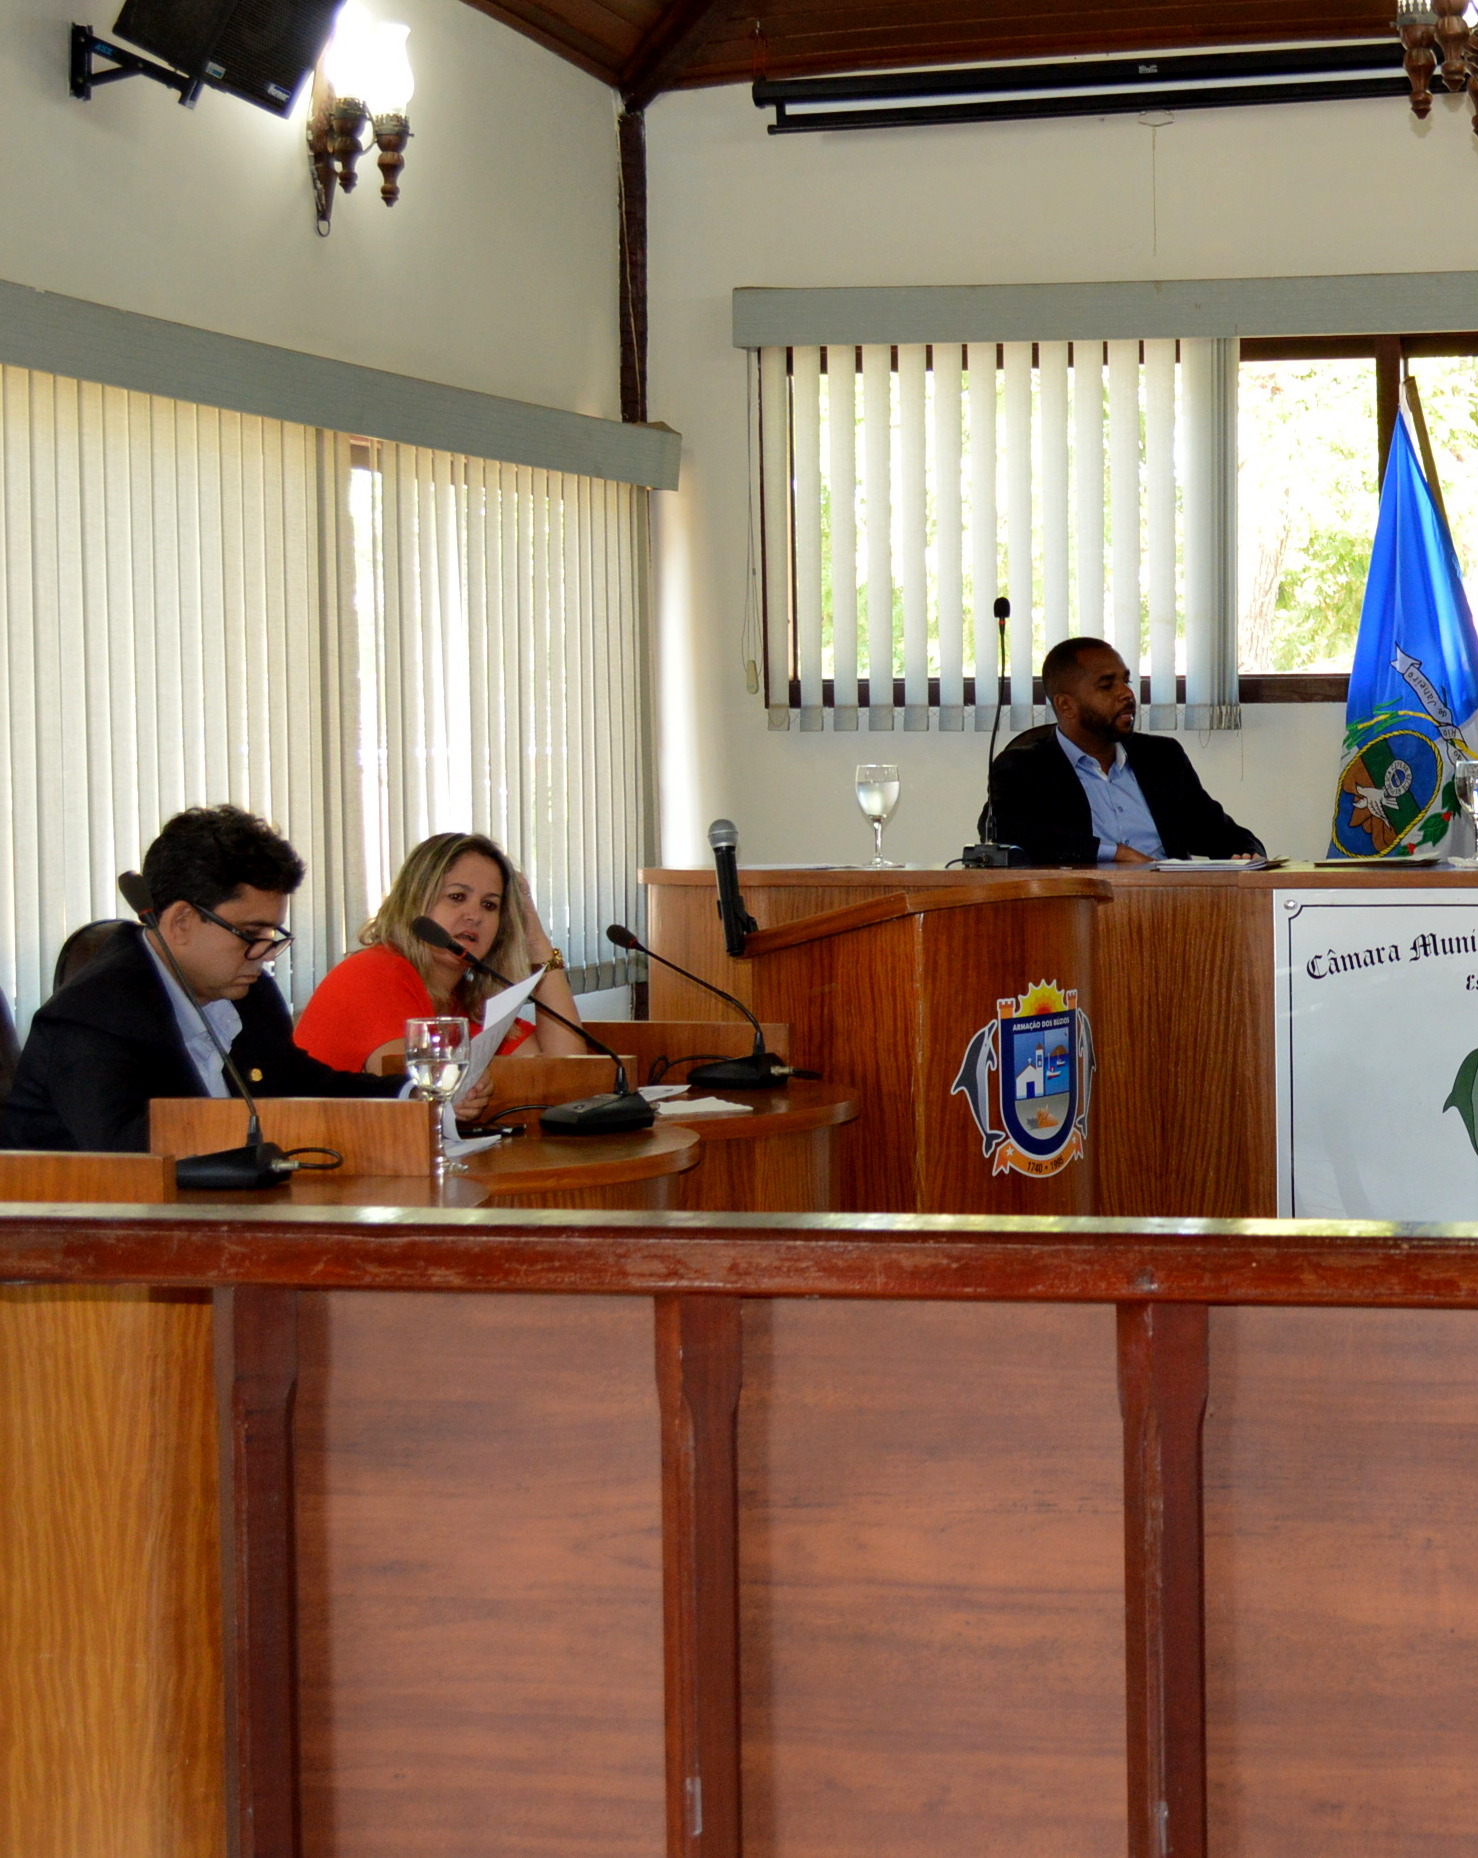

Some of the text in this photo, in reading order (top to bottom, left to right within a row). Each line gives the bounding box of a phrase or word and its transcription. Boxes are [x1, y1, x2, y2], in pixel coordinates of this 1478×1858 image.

[1407, 671, 1437, 707] Janeiro
[1306, 944, 1401, 980] Câmara
[1013, 1016, 1070, 1031] ARMAÇÃO DOS BÚZIOS
[1027, 1161, 1043, 1173] 1740
